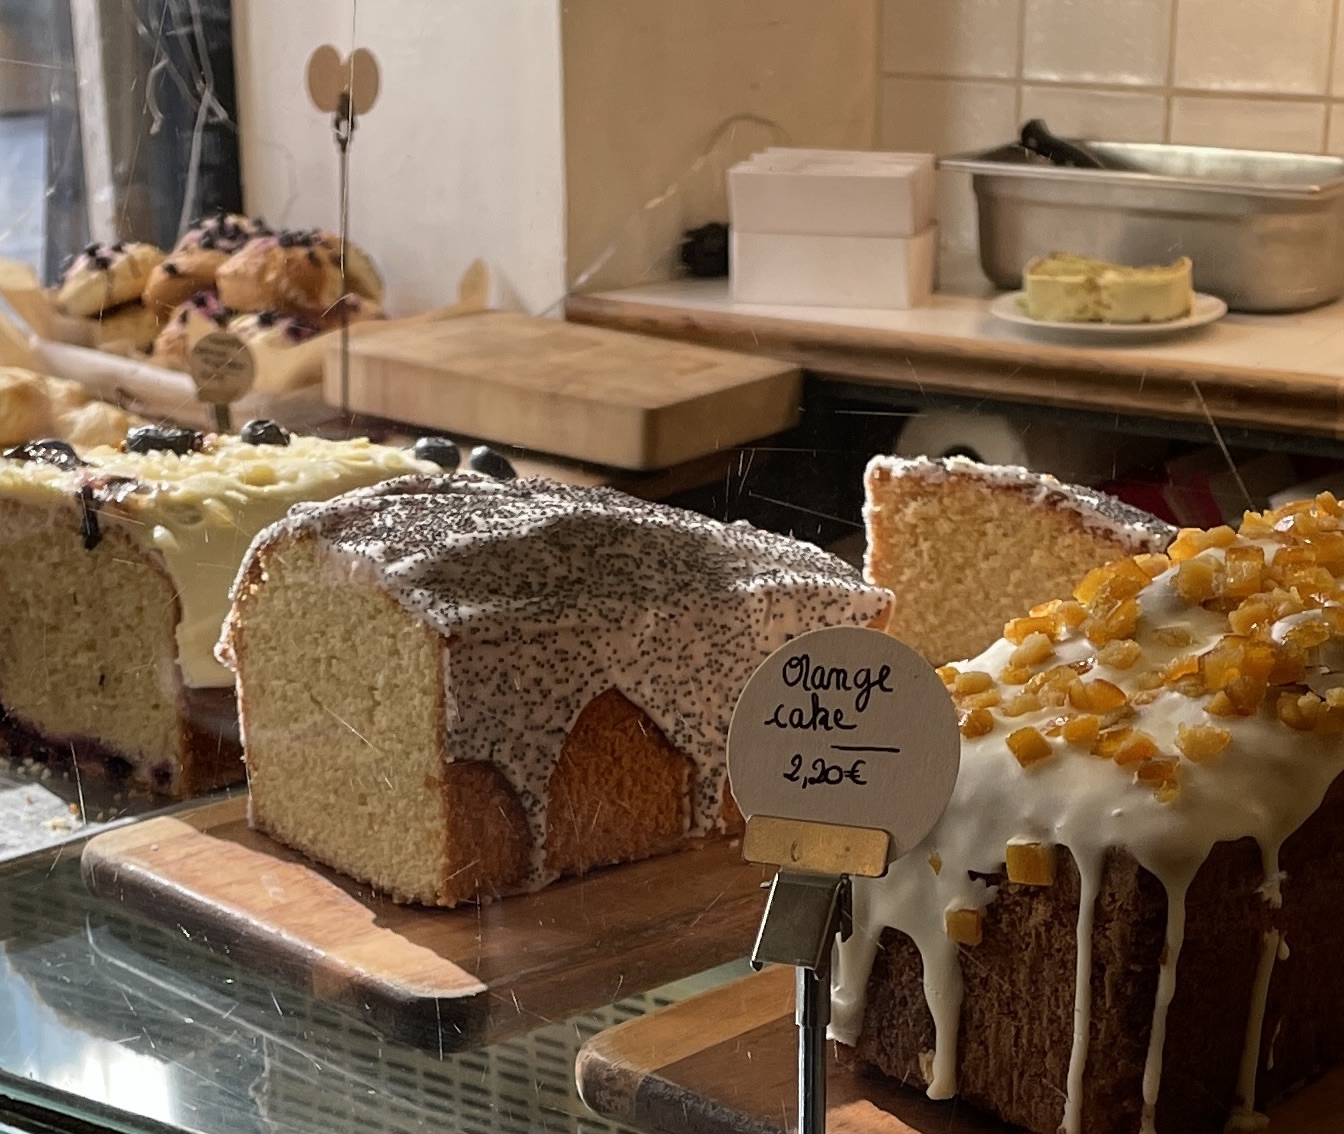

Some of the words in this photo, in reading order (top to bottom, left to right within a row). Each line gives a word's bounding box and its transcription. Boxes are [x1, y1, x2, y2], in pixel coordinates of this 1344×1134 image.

[783, 654, 893, 712] Orange
[764, 692, 858, 731] cake
[783, 754, 868, 789] 2,20€
